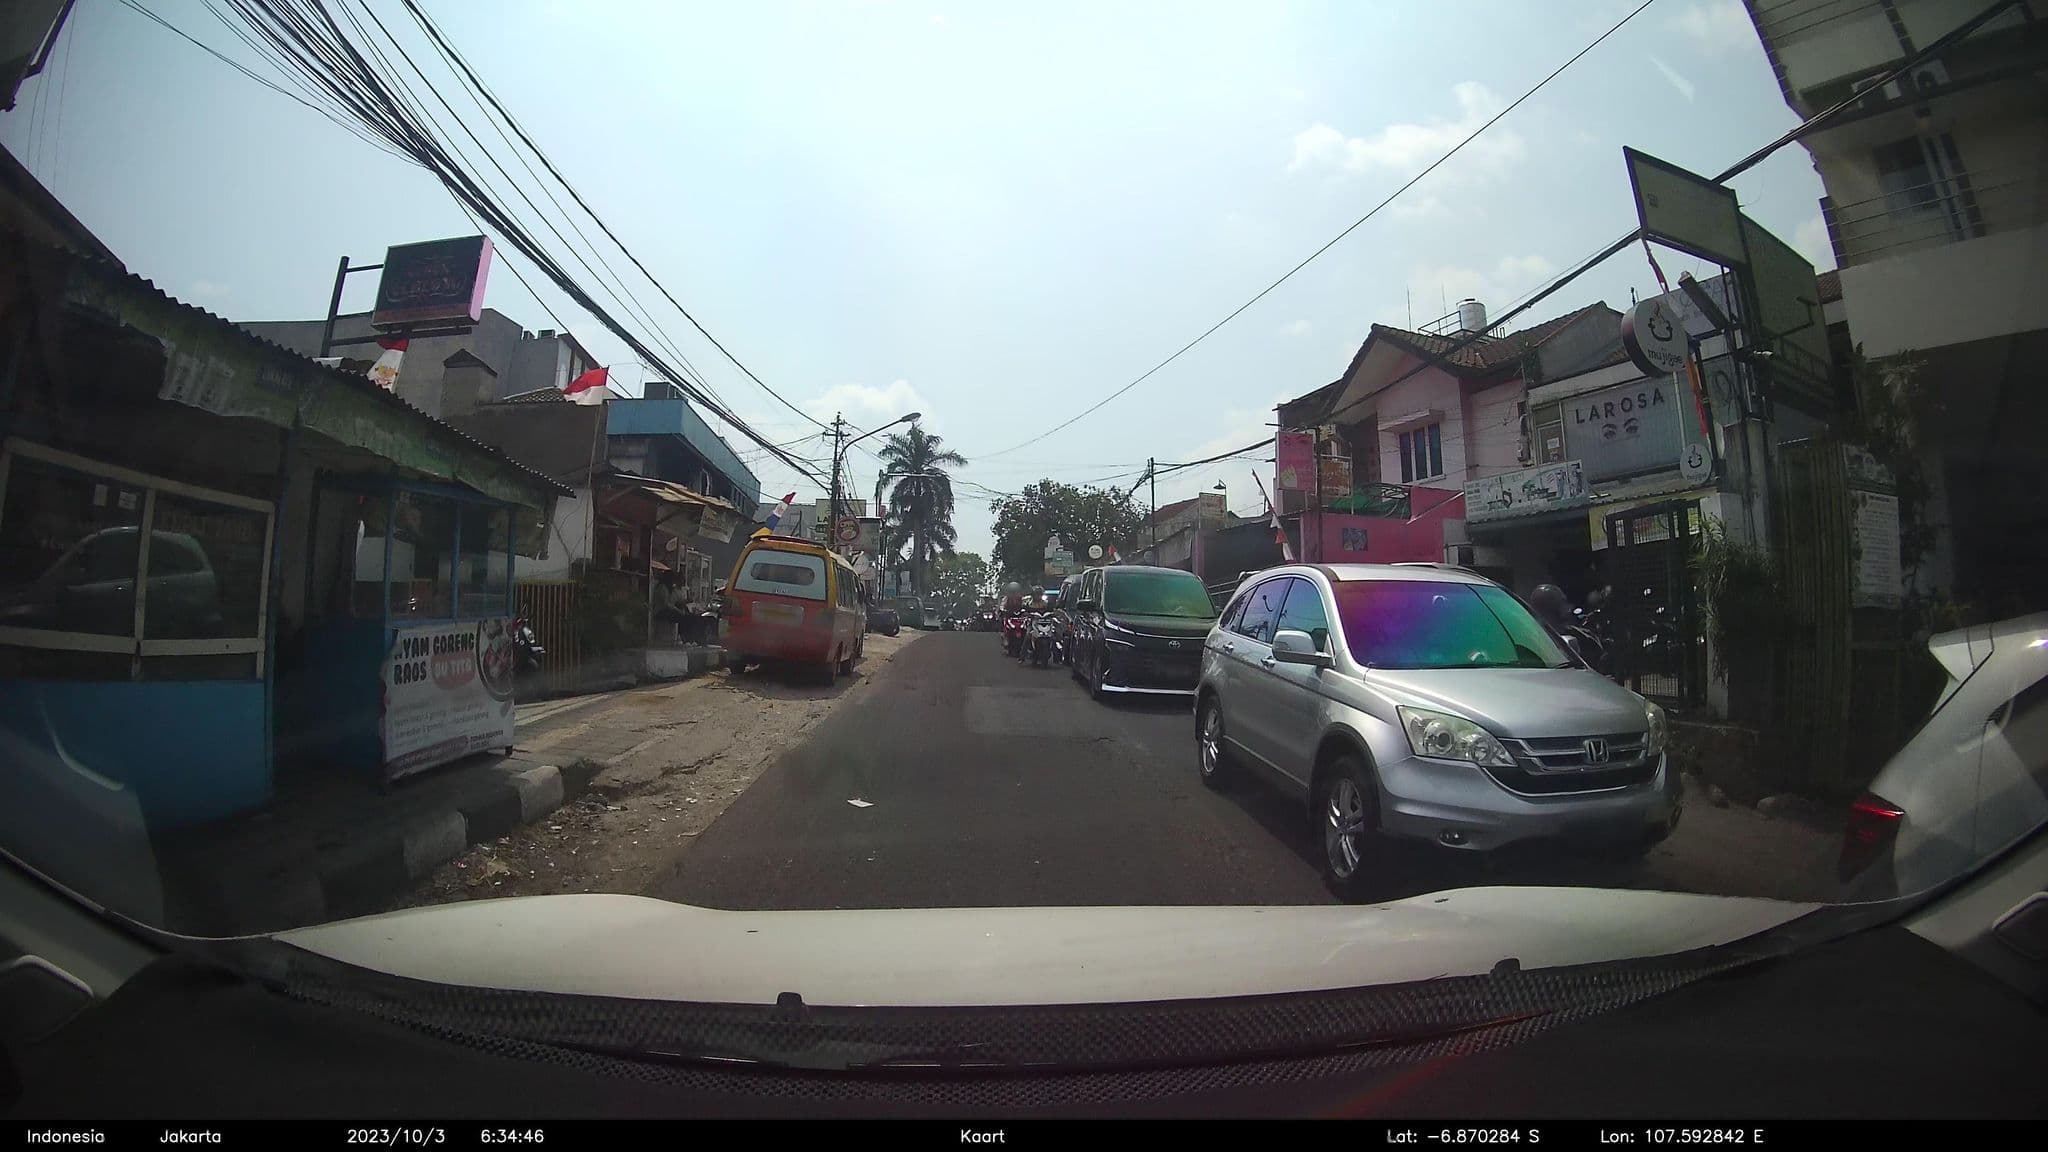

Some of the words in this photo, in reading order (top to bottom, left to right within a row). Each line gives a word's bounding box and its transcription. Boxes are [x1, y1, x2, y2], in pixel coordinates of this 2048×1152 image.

[1575, 387, 1665, 424] LAROSA
[433, 633, 475, 655] GORENG
[394, 661, 427, 686] RAOS
